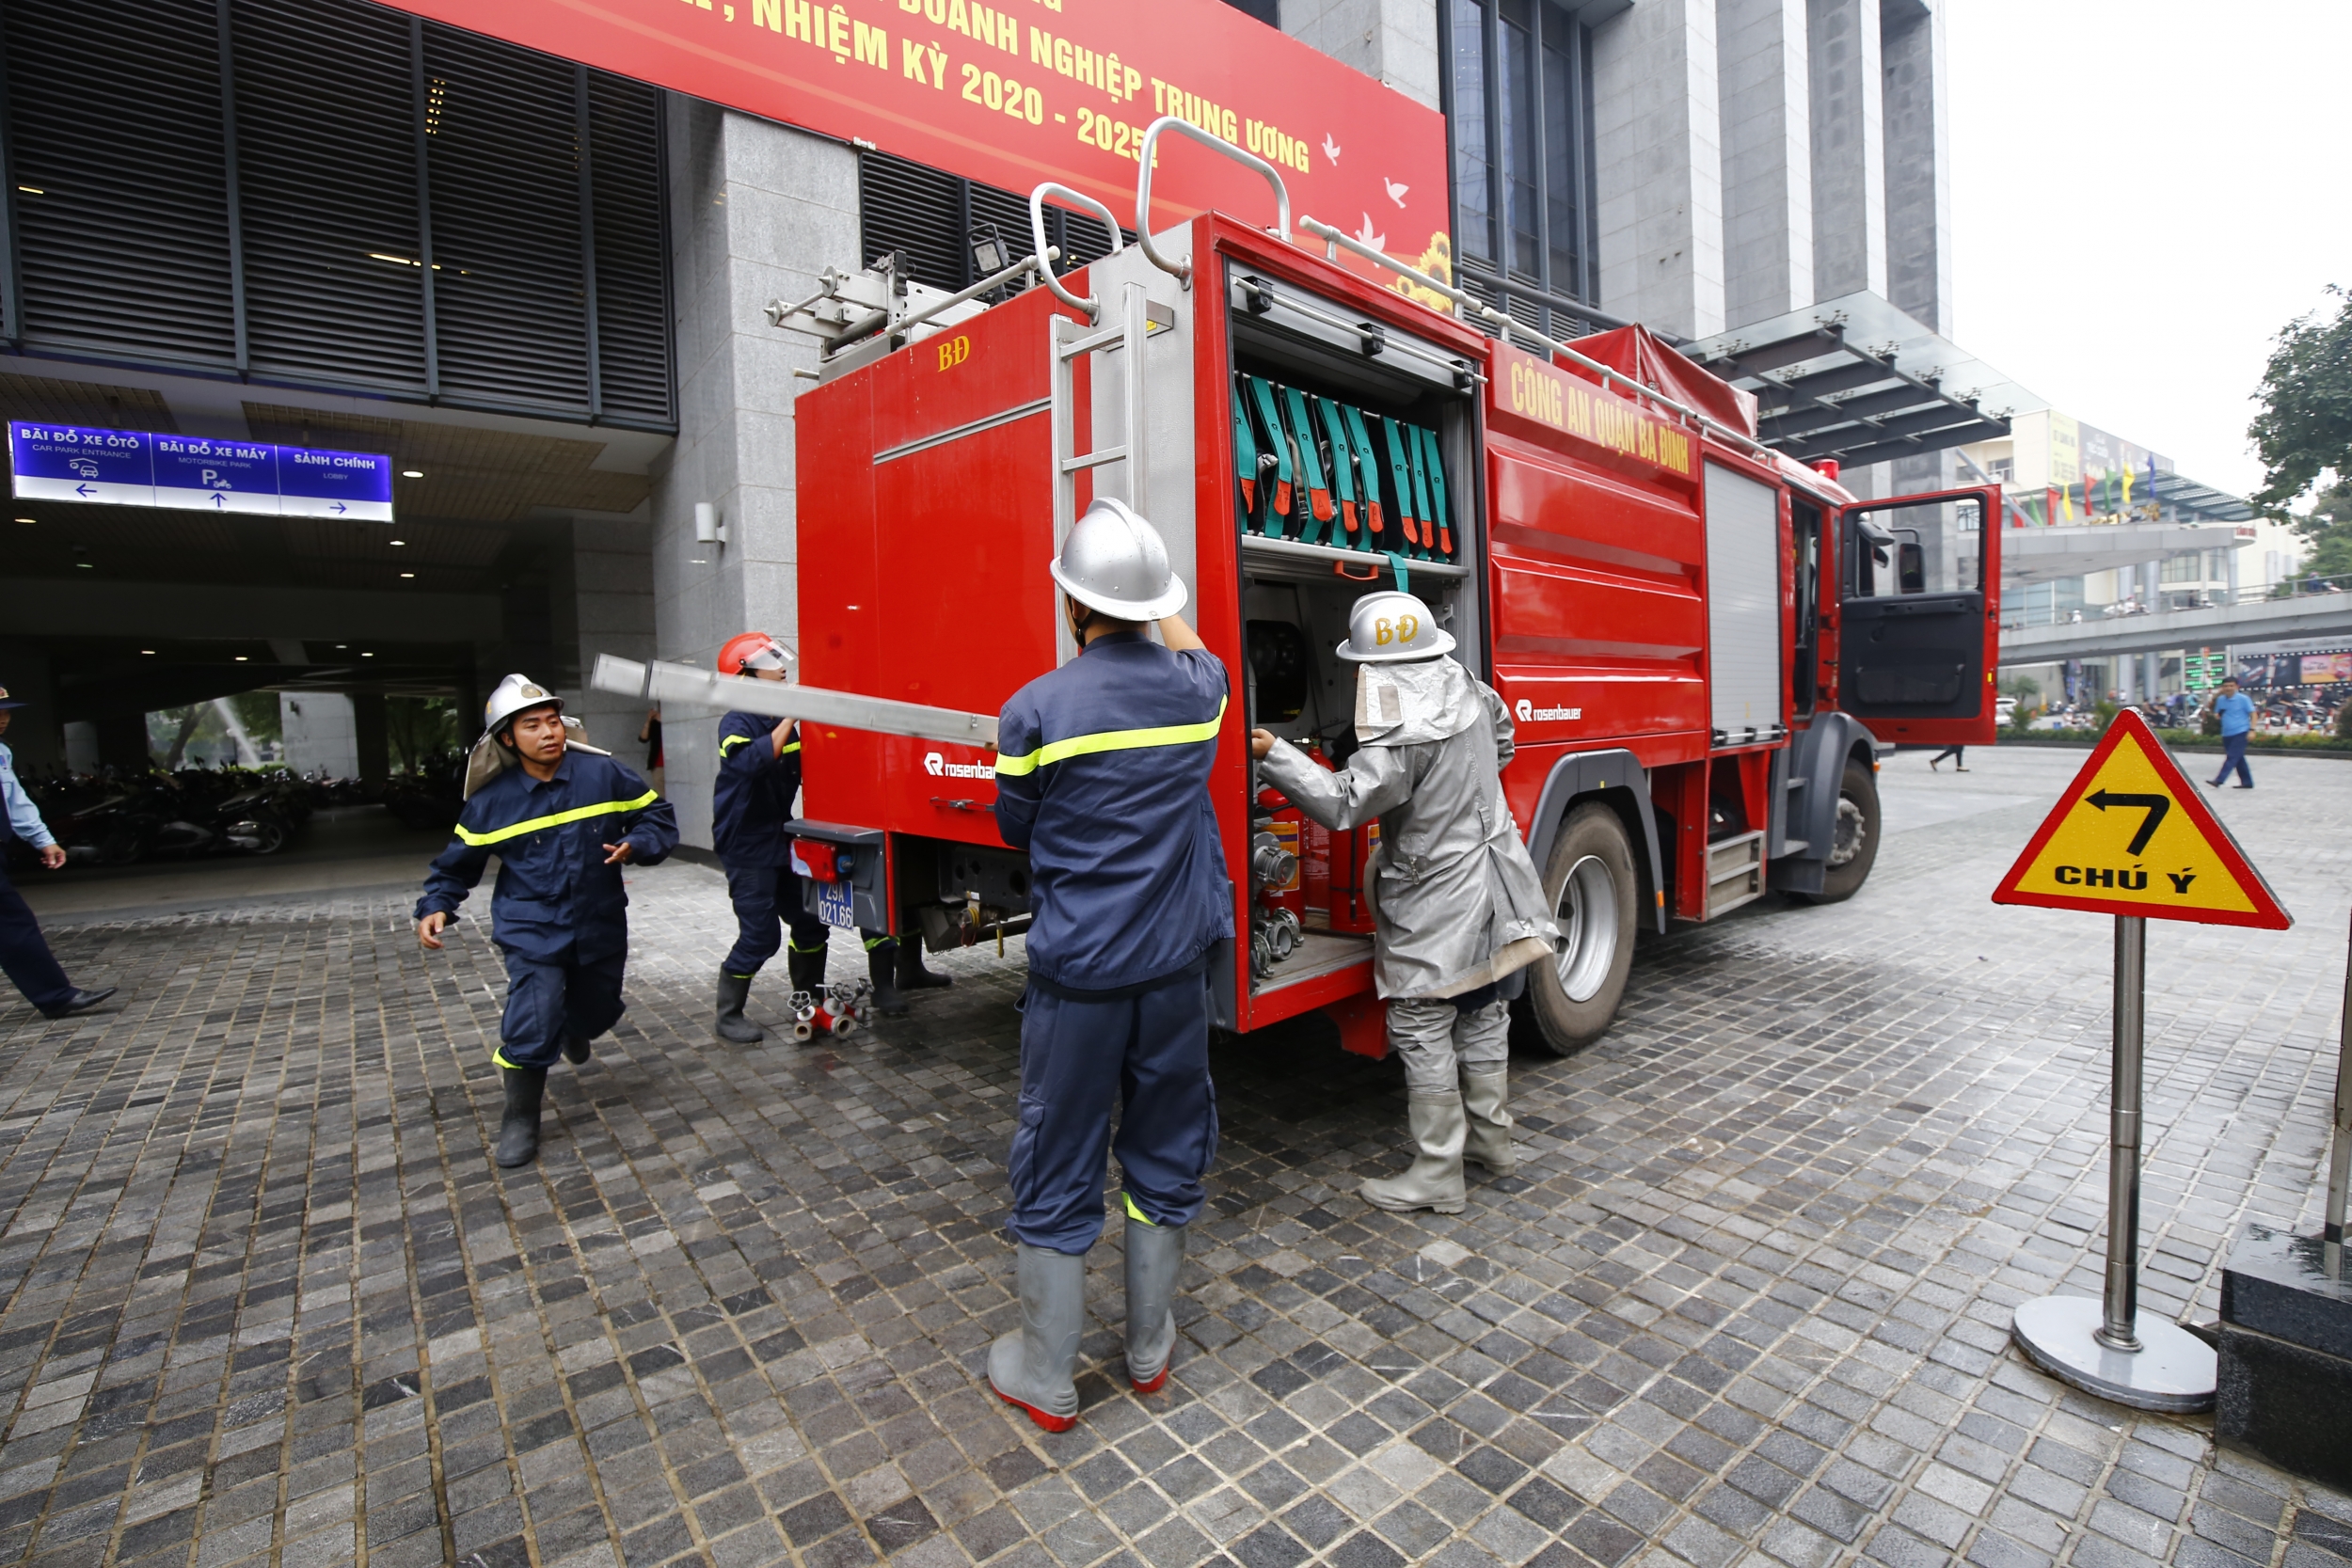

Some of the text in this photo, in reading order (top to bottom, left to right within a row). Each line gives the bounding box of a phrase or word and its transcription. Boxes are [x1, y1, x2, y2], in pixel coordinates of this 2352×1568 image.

[753, 0, 888, 71] NHIỆM
[902, 40, 948, 90] KỲ
[961, 63, 1043, 125] 2020
[899, 0, 1310, 174] OANH NGHIỆP TRUNG ƯƠNG
[937, 335, 970, 372] BĐ
[1511, 357, 1689, 474] CÔNG AN QUẬN BA ĐÌNH
[21, 427, 139, 449] BÃI ĐỖ XE ÔTÔ
[55, 446, 80, 454] PARK
[82, 448, 132, 459] ENTRANCE
[159, 440, 267, 460] BÃI ĐỖ XE MÁY
[294, 451, 375, 469] SẢNH CHÍNH
[178, 456, 228, 467] MOTORBIKE
[1533, 703, 1581, 721] rosenbauer
[945, 759, 995, 780] rosenba
[2055, 863, 2197, 894] CHÚ Ý
[819, 900, 851, 928] 021.66
